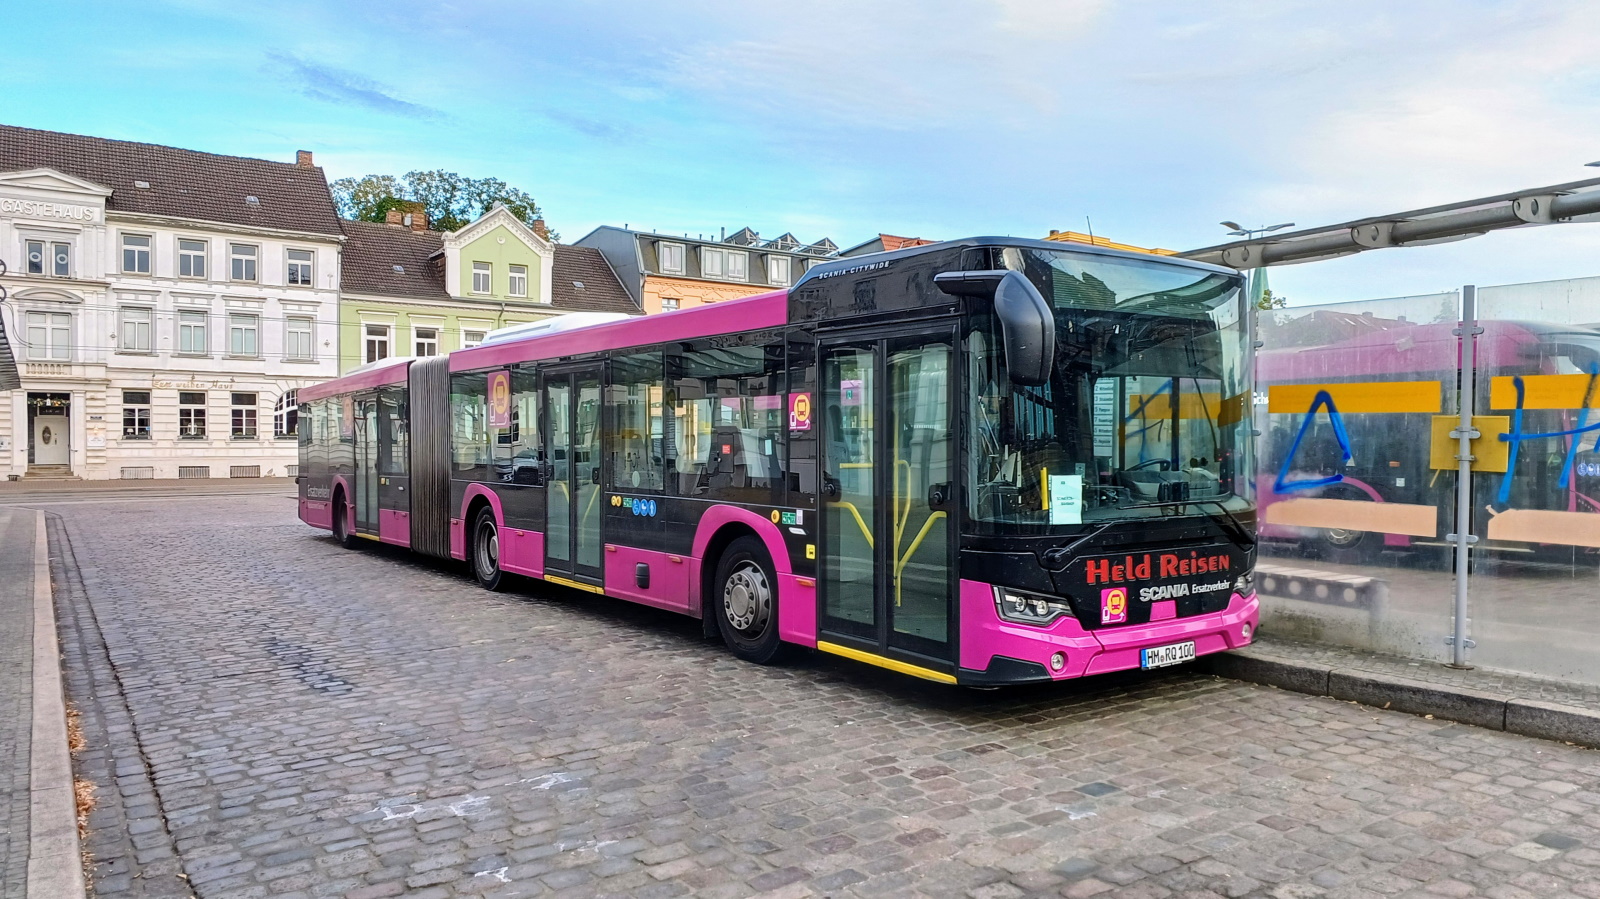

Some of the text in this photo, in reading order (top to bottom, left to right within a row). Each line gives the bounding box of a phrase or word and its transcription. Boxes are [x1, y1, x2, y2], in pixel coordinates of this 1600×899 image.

[819, 261, 890, 280] SCANIA CITYWIDE
[1086, 554, 1151, 585] Held
[1140, 580, 1231, 602] SCANIA Ersatzverkehr
[1179, 643, 1194, 659] 100
